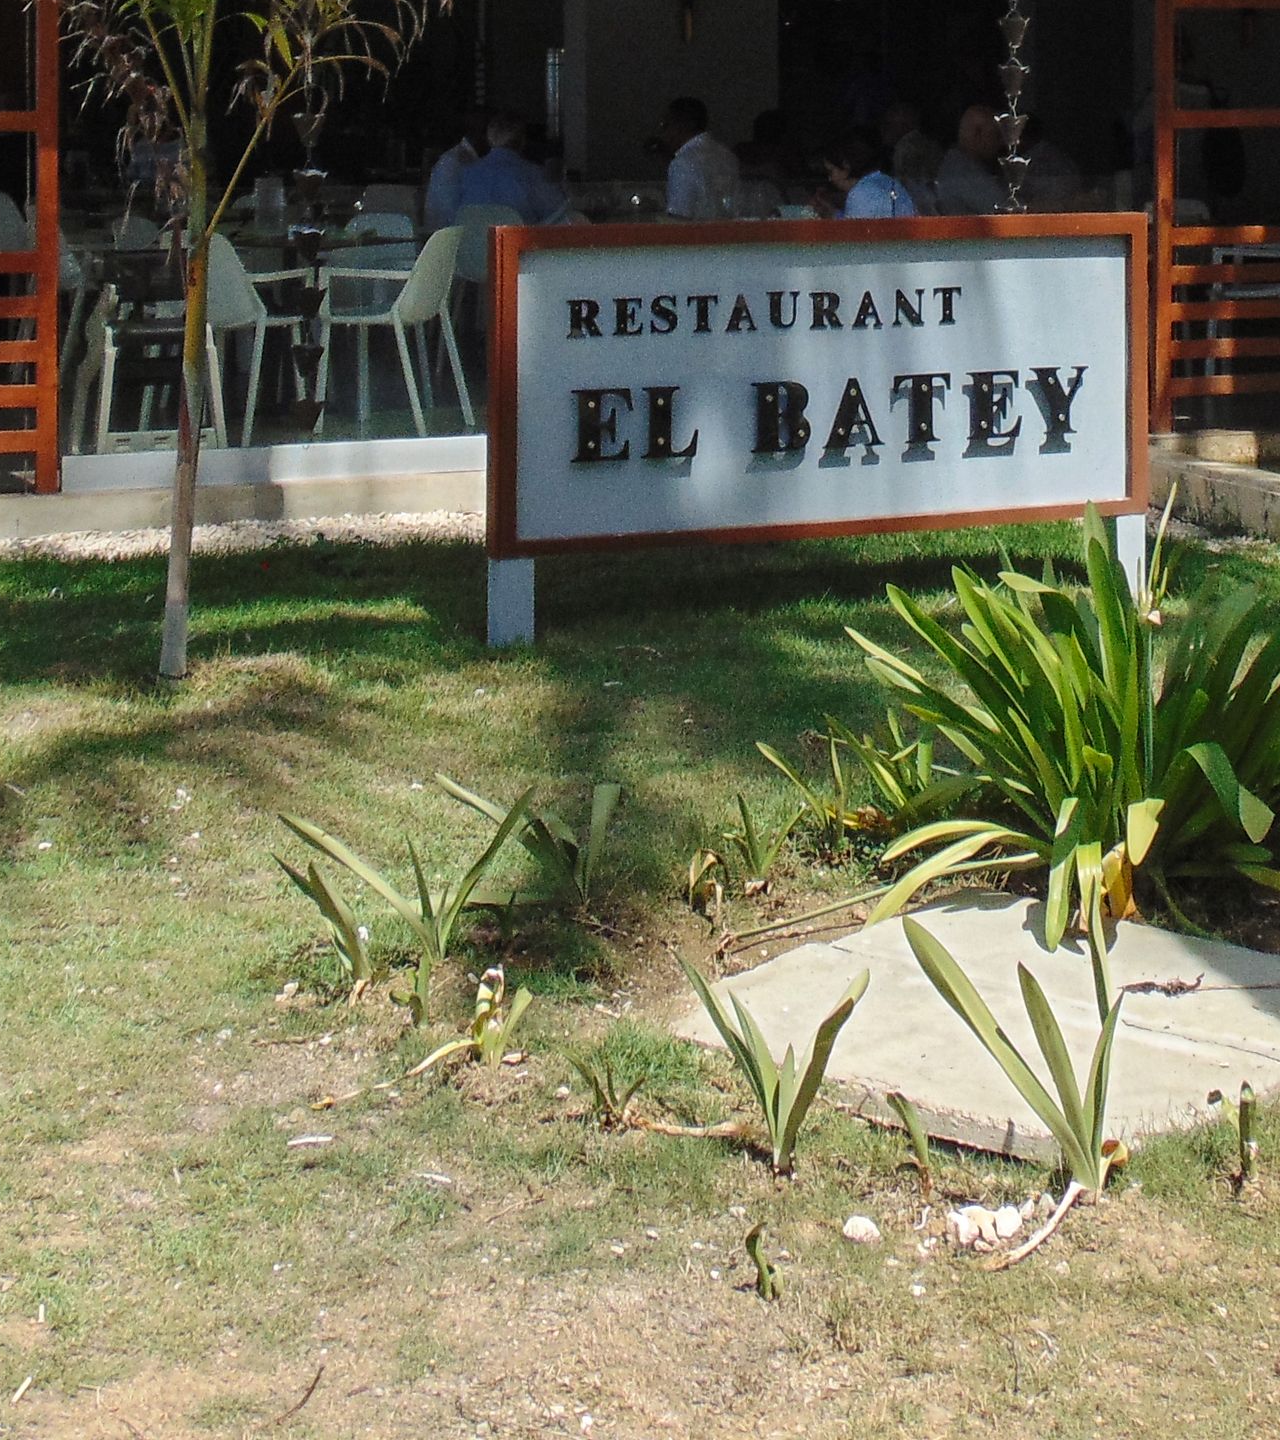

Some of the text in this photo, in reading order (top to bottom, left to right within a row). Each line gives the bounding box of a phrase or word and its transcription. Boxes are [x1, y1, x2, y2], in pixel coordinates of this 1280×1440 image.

[567, 285, 962, 339] RESTAURANT
[570, 365, 1089, 463] EL BATEY
